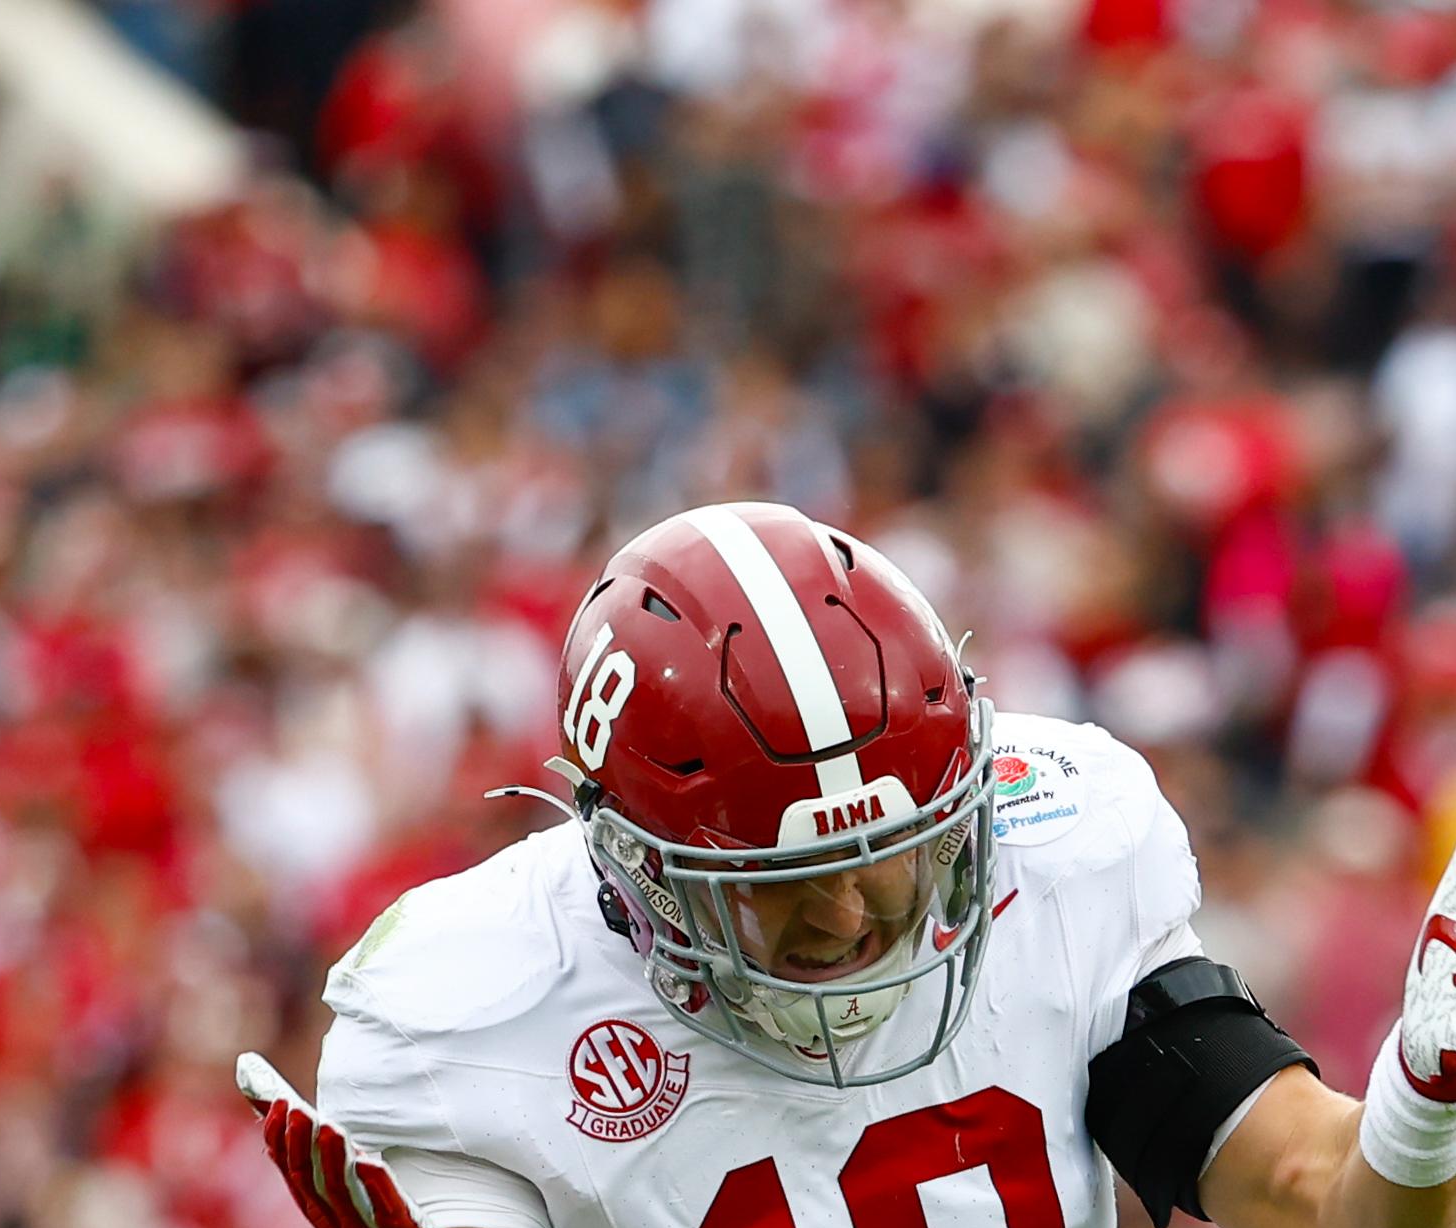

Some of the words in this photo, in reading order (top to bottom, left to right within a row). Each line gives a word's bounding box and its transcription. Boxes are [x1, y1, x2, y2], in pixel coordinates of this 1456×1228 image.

[563, 621, 636, 772] 18
[1029, 746, 1079, 778] GAME
[812, 794, 885, 837] BAMA
[996, 791, 1041, 814] presented
[1042, 790, 1055, 804] by
[1010, 803, 1079, 829] Prudential
[629, 867, 684, 924] RIMSON
[840, 996, 861, 1020] A
[574, 1024, 657, 1109] SEC
[590, 1079, 683, 1137] GRADUATE
